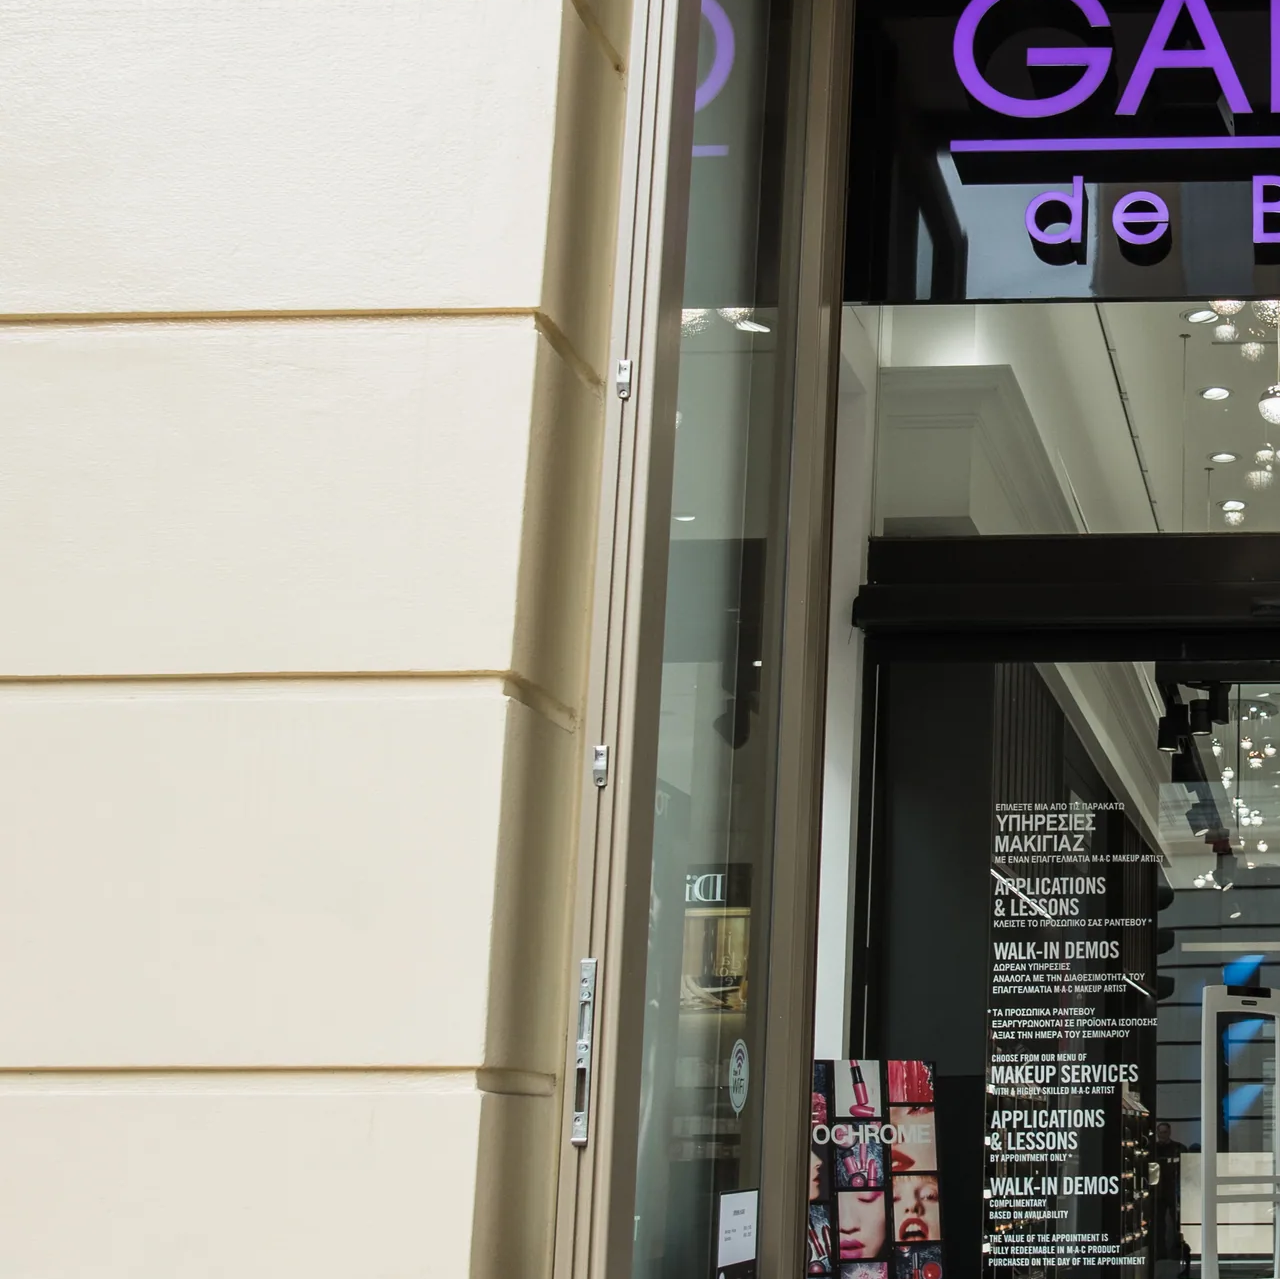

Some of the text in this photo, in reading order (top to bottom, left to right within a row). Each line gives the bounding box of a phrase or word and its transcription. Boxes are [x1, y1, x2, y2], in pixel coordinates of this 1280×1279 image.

[1024, 176, 1169, 244] de
[996, 814, 1096, 831] ΥΠΗΡΕΣΙΕΣ
[995, 835, 1084, 852] ΜΑΚΙΓΙΑΖ
[1112, 855, 1139, 863] MAKEUP
[994, 877, 1106, 895] APPLICATIONS
[994, 898, 1079, 917] & LESSONS
[994, 941, 1119, 960] WALK-IN DEMOS
[991, 1053, 1087, 1062] CHOOSE FROM OUR MENU OF
[991, 1065, 1138, 1084] MAKEUP SERVICES
[1042, 1086, 1069, 1094] SKILLED
[1091, 1086, 1115, 1094] ARTIST
[991, 1110, 1105, 1128] APPLICATIONS
[812, 1124, 931, 1145] OCHROME
[990, 1131, 1078, 1151] & LESSONS
[990, 1154, 1067, 1162] BY APPOINTMENT ONLY
[990, 1176, 1119, 1195] WALK-IN DEMOS
[989, 1199, 1047, 1208] COMPLIMENTARY
[989, 1211, 1068, 1219] BASED ON AVAILABILITY
[989, 1234, 1108, 1242] THE VALUE OF THE APPOINTMENT IS
[1010, 1246, 1055, 1254] REDEEMABLE
[1057, 1246, 1065, 1254] IN
[1088, 1245, 1120, 1254] PRODUCT
[988, 1257, 1145, 1266] PURCHASED ON THE DAY OF THE APPOINTMENT
